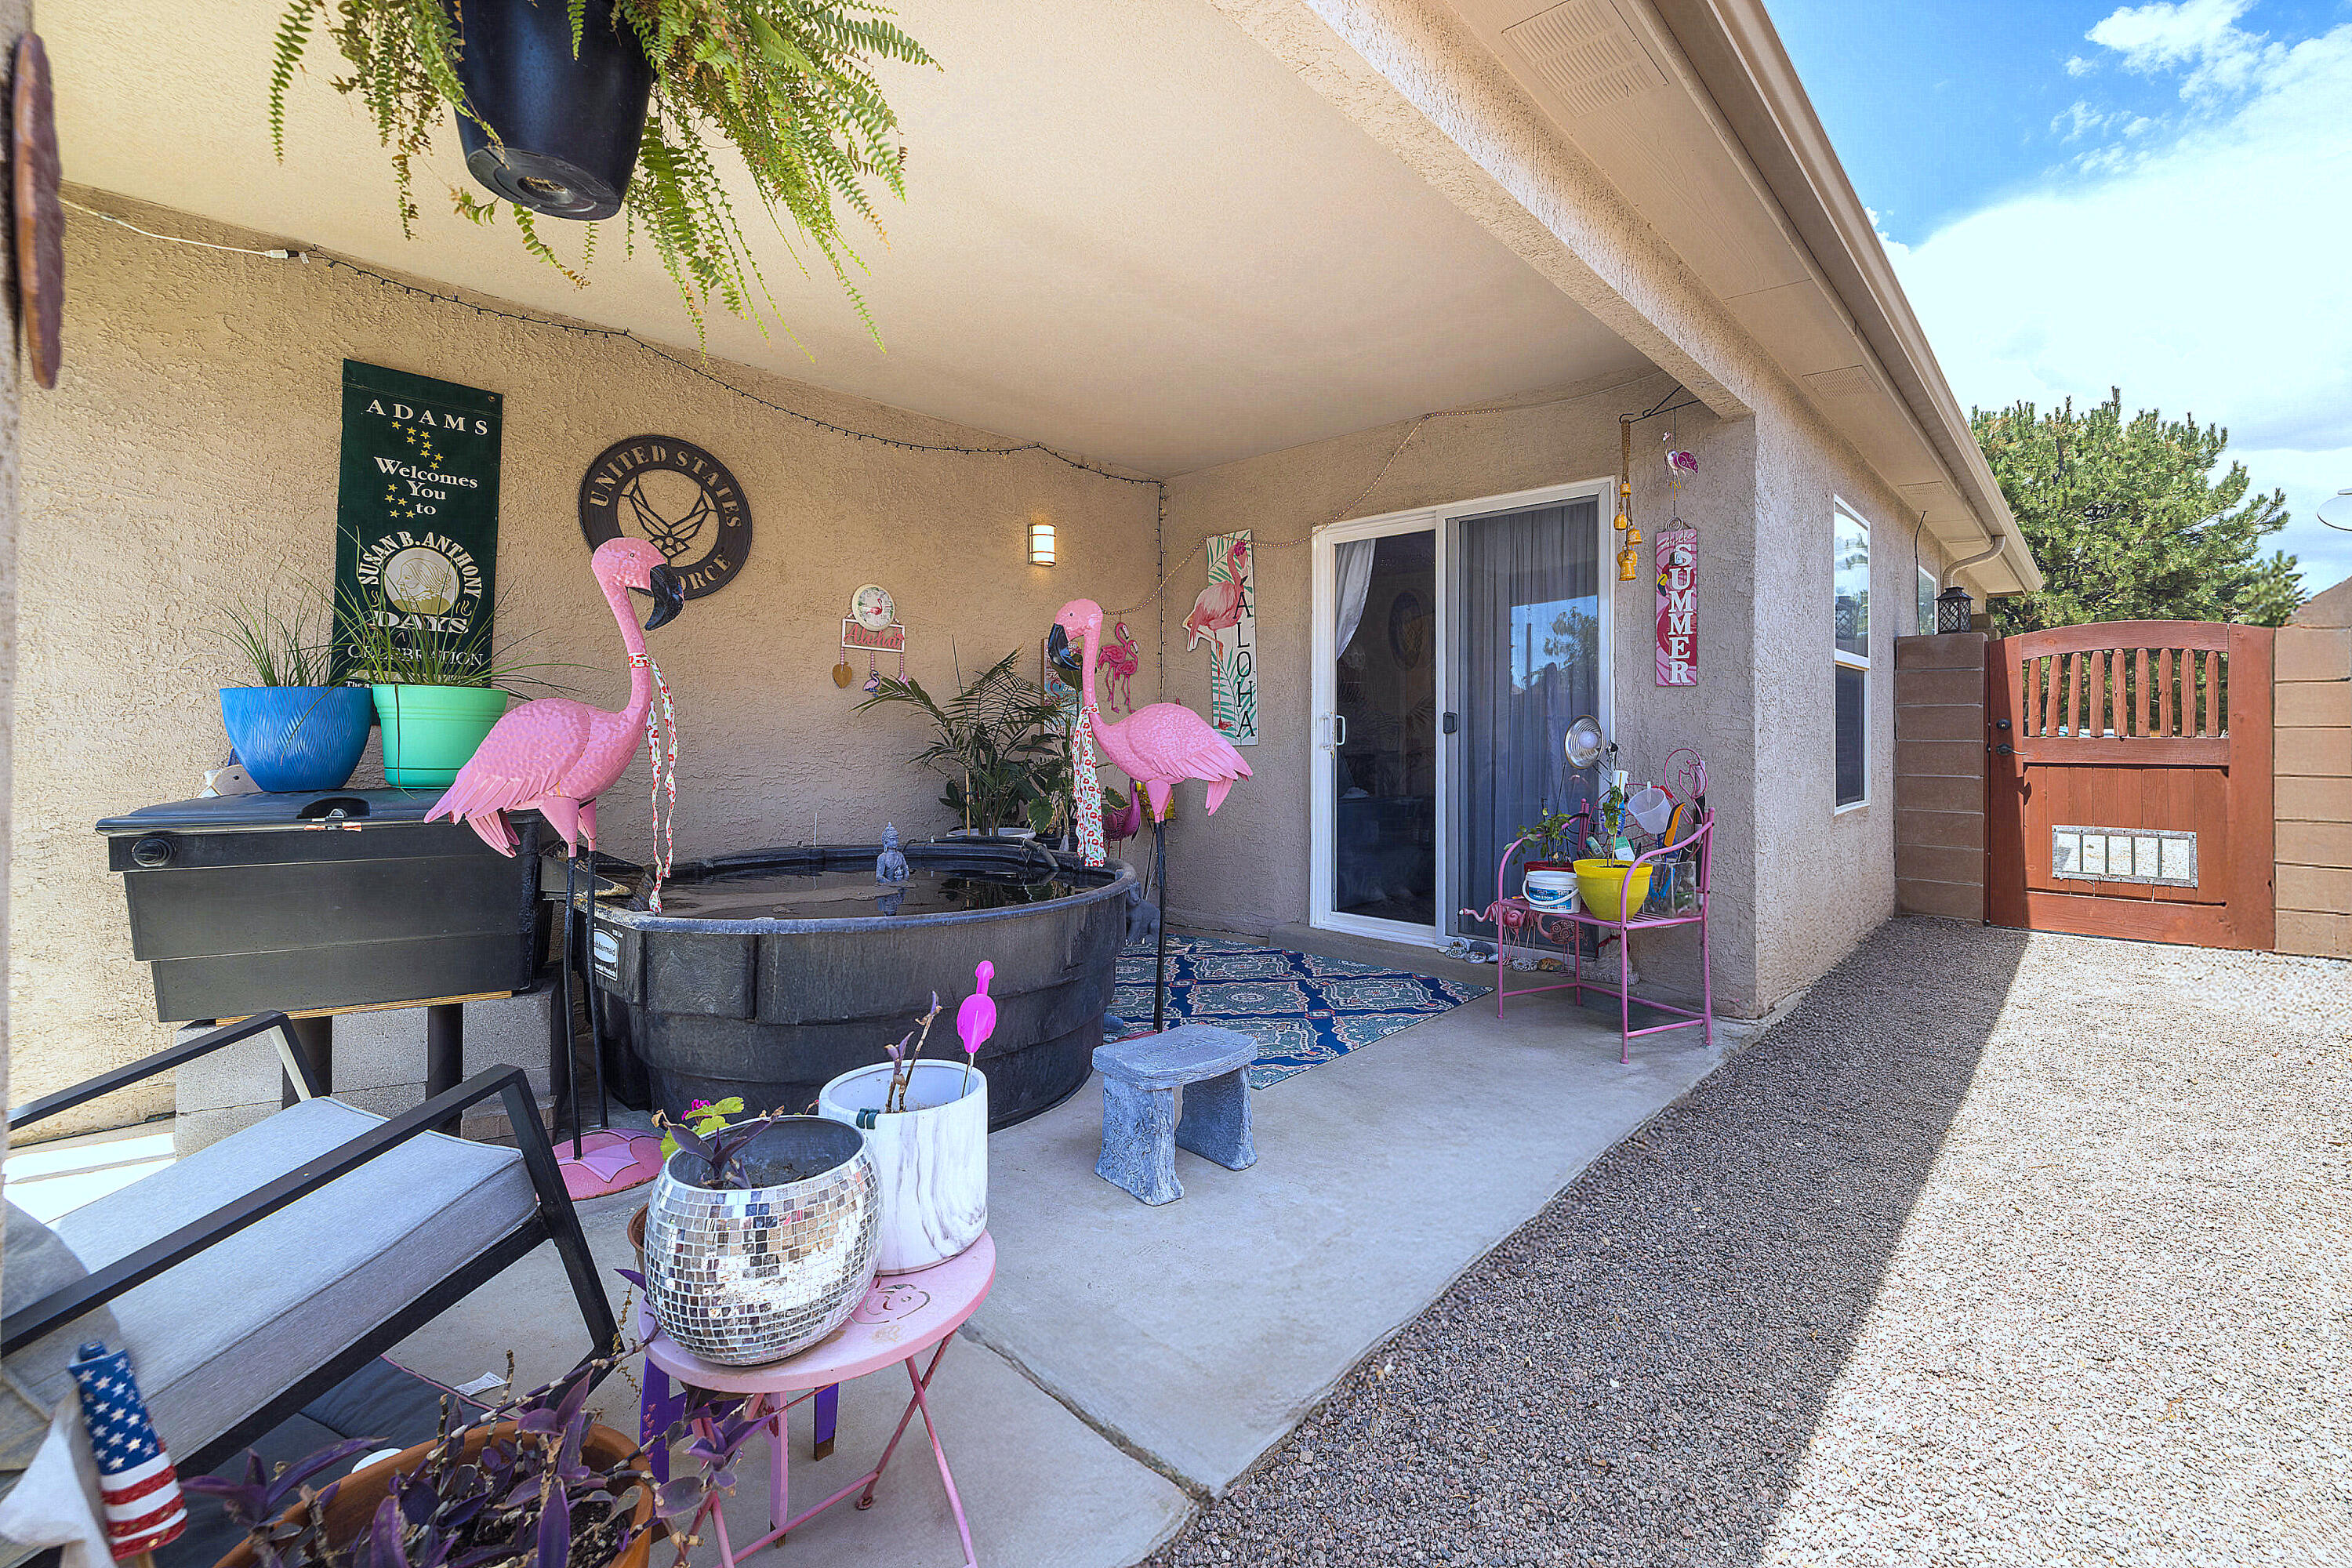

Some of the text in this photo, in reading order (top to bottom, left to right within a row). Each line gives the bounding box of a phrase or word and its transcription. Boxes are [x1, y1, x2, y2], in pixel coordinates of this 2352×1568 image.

[366, 398, 488, 435] ADAMS
[373, 456, 478, 489] Welcomes
[406, 480, 447, 500] You
[590, 445, 742, 528] UNITED STATES
[416, 502, 437, 516] to
[358, 531, 482, 599] SUSAN B. ANTHONY
[676, 554, 730, 590] ORCE
[368, 610, 469, 634] DAYS
[1668, 543, 1694, 684] SUMMER
[844, 623, 902, 649] Aloha
[1232, 591, 1255, 738] ALOHA
